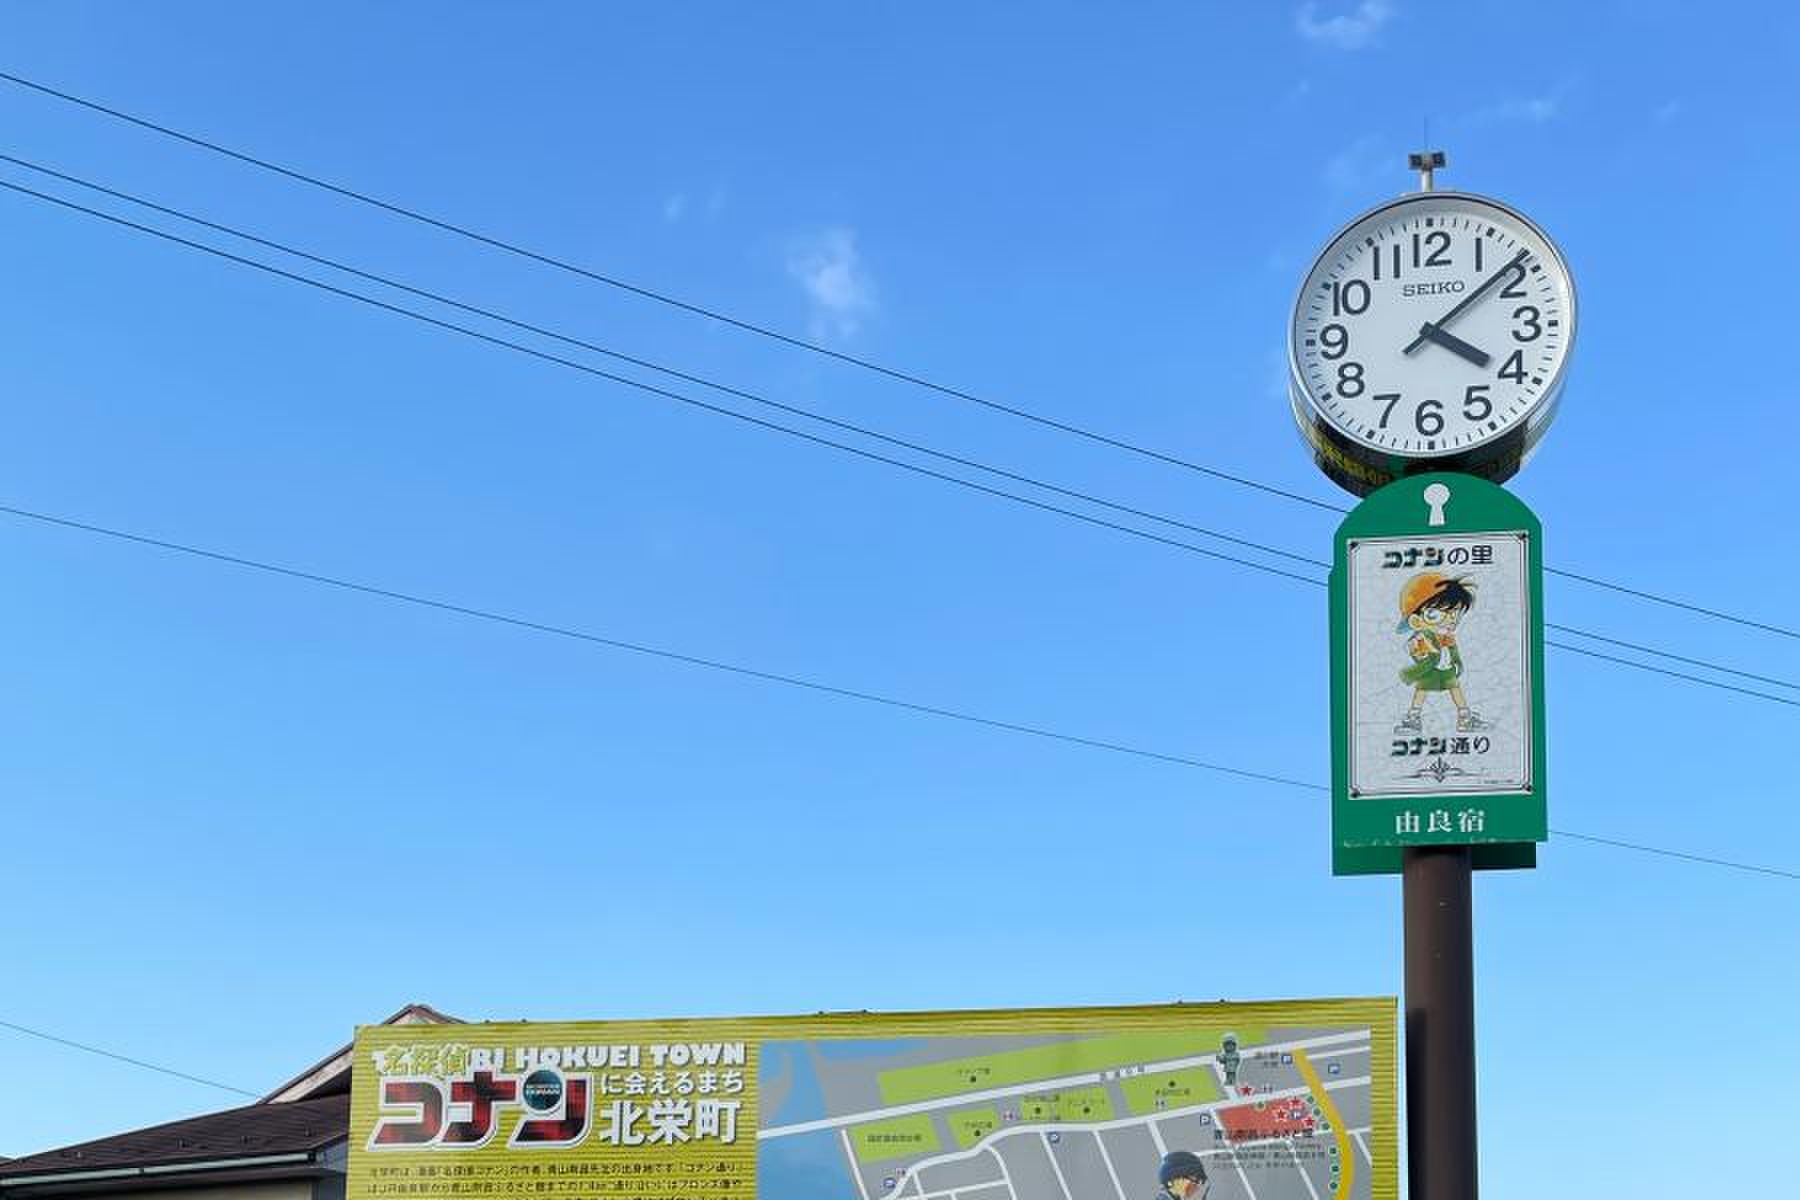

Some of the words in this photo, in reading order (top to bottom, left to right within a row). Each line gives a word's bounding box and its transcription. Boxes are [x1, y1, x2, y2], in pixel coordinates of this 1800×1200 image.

[1373, 243, 1401, 281] 11
[1413, 231, 1452, 268] 12
[1474, 237, 1484, 273] 1
[1332, 278, 1372, 317] 10
[1402, 280, 1466, 297] SEIKO
[1499, 261, 1528, 299] 2
[1319, 323, 1349, 360] 9
[1511, 305, 1542, 342] 3
[1336, 362, 1366, 399] 8
[1497, 350, 1528, 385] 4
[1372, 393, 1402, 429] 7
[1415, 399, 1445, 436] 6
[1462, 385, 1493, 421] 5
[1382, 545, 1494, 569] コナンの里
[1390, 735, 1491, 757] コナン通り
[1394, 808, 1486, 835] 由良宿
[515, 1045, 641, 1069] HOKUEI
[649, 1042, 745, 1067] TOWN
[601, 1071, 744, 1095] に会えるまち
[367, 1068, 594, 1151] コナン
[600, 1098, 741, 1146] 北栄町
